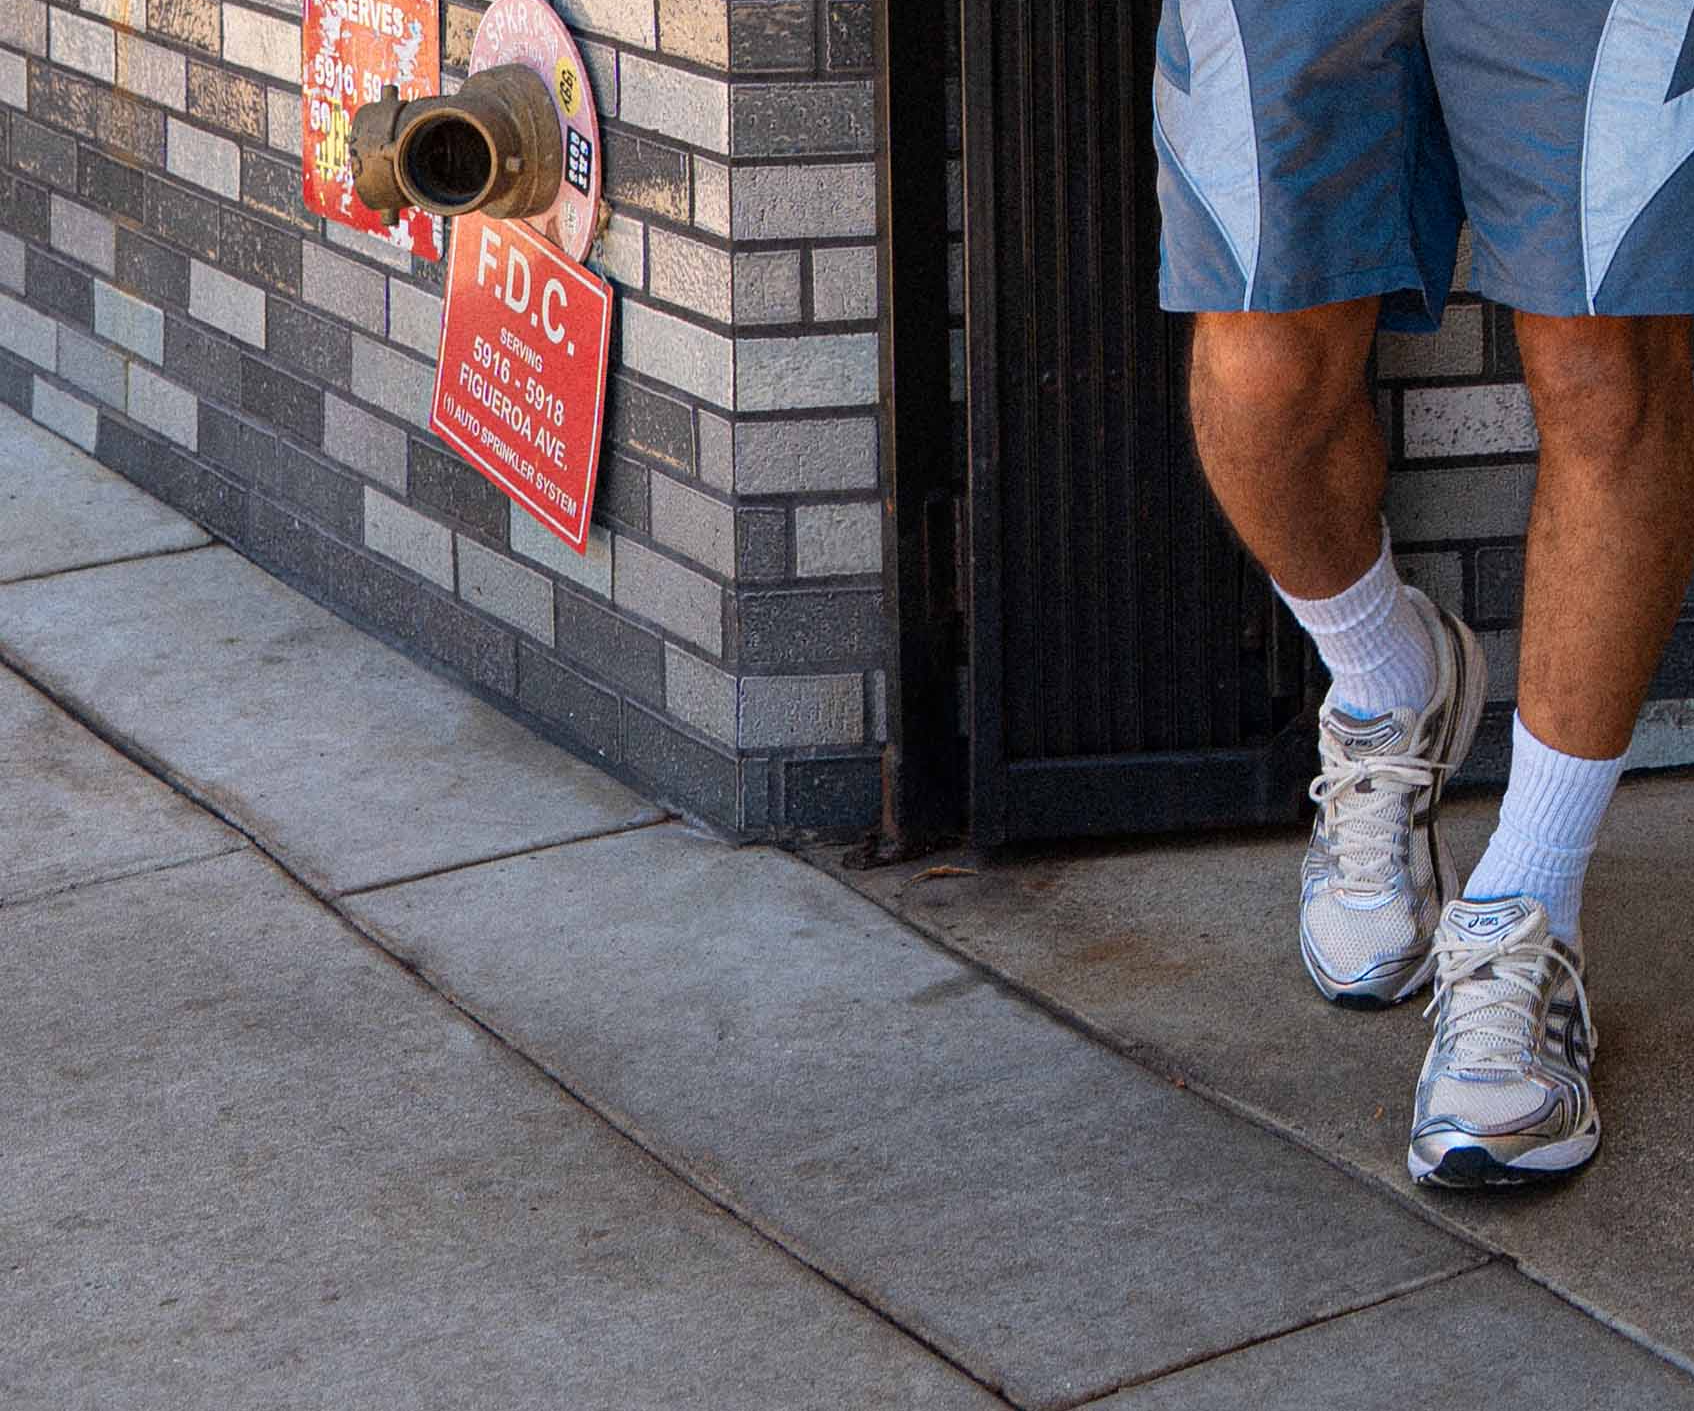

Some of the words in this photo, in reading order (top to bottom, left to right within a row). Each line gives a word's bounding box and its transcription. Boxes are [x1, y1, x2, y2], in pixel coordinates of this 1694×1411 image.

[477, 224, 575, 357] F.D.C.
[472, 335, 511, 385] 5916
[524, 380, 565, 427] 5918
[499, 327, 544, 374] SERVING
[443, 392, 456, 416] (1)
[453, 405, 481, 437] AUTO
[480, 426, 535, 481] SPRINKLER
[536, 471, 578, 519] SYSTEM
[459, 362, 532, 443] FIGUEROA
[534, 432, 569, 472] AVE.
